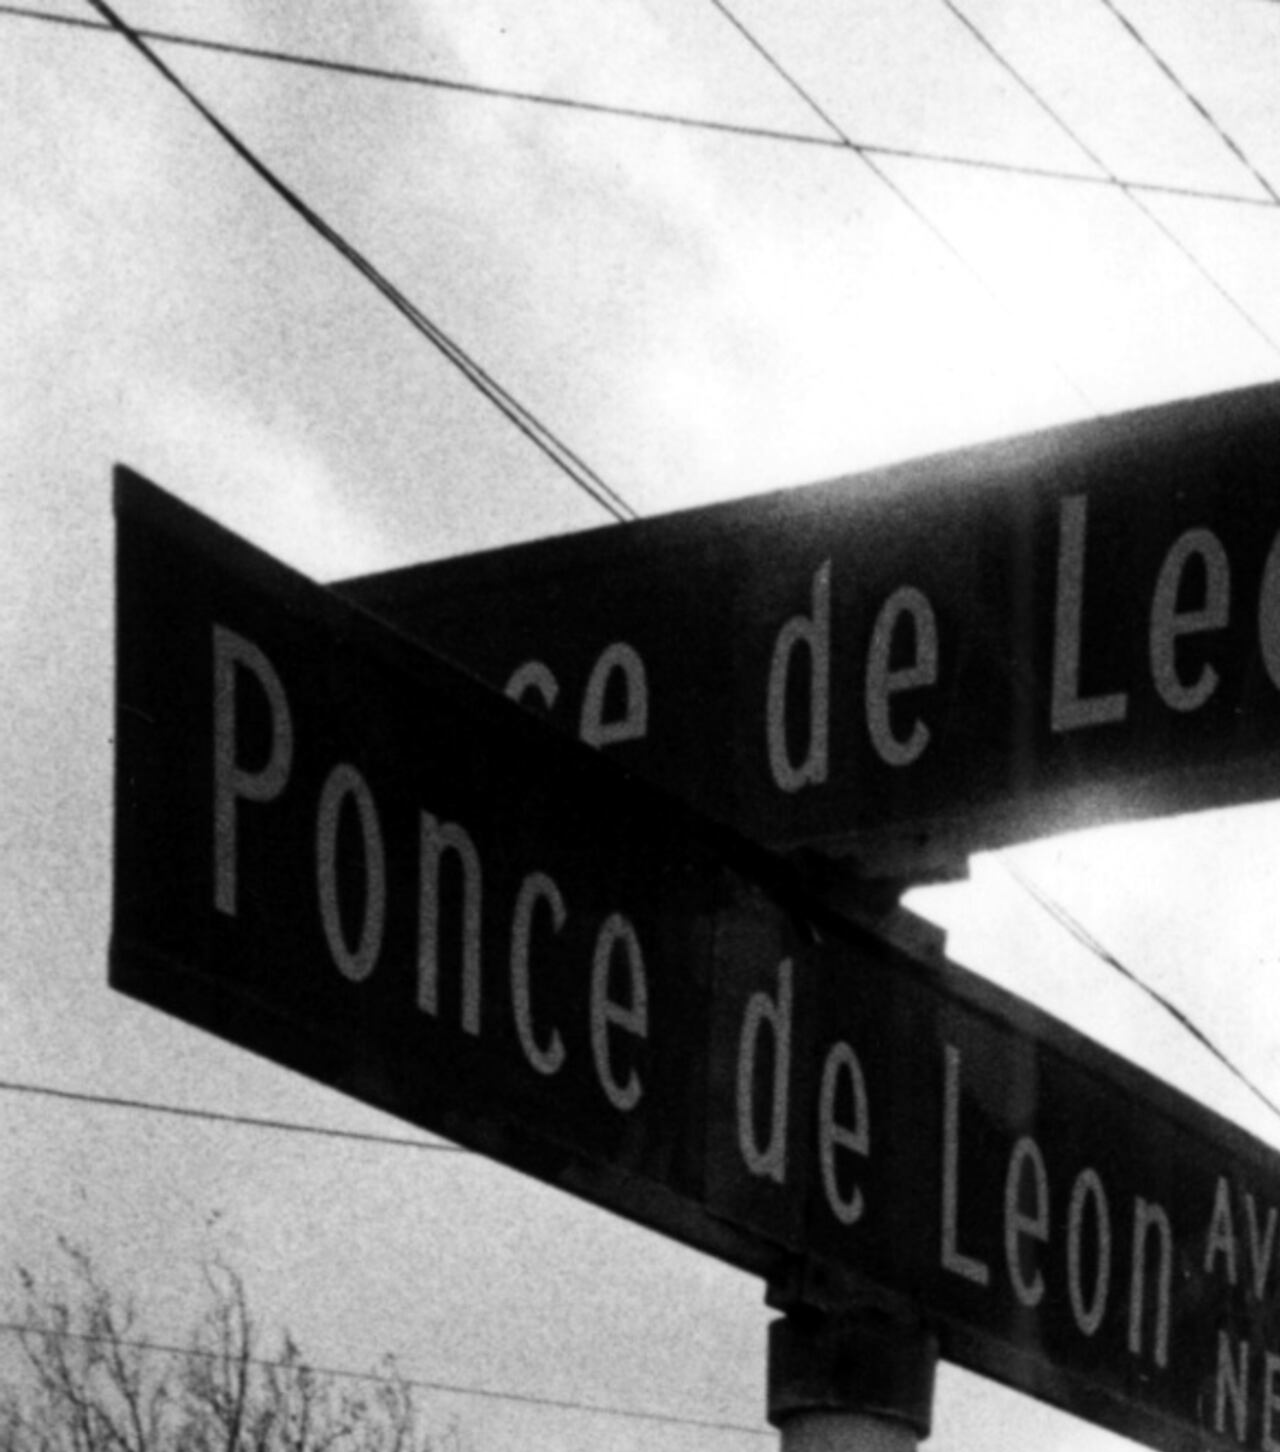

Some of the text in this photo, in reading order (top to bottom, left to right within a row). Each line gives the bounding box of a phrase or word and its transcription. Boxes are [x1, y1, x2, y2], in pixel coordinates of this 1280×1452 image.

[766, 556, 939, 793] de
[211, 622, 651, 1112] Ponce
[737, 958, 871, 1227] de
[940, 1045, 1174, 1370] Leon
